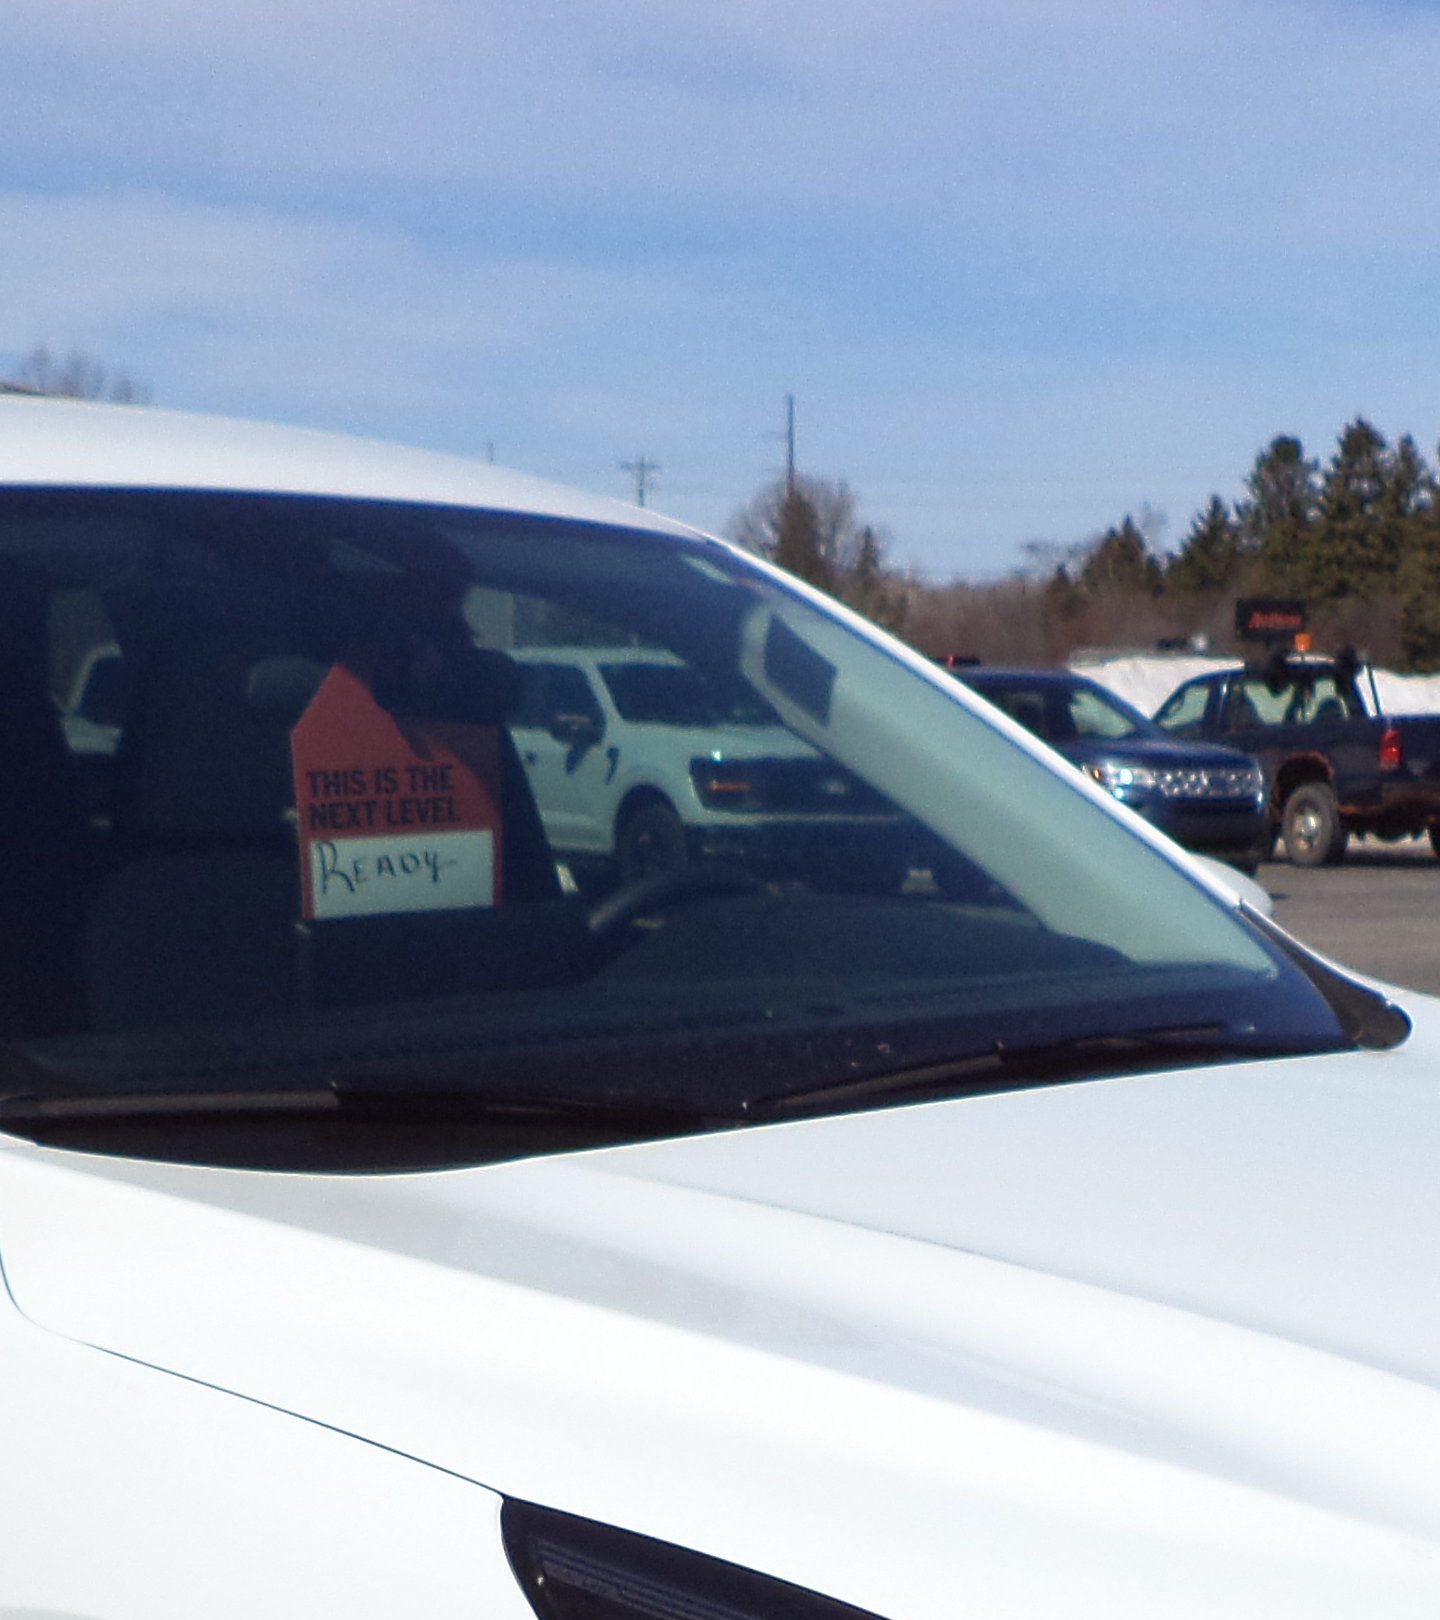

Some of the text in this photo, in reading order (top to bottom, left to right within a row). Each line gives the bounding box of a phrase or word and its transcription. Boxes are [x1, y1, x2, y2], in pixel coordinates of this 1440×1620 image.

[307, 764, 454, 798] THIS IS THE
[308, 797, 462, 830] NEXT LEVEL
